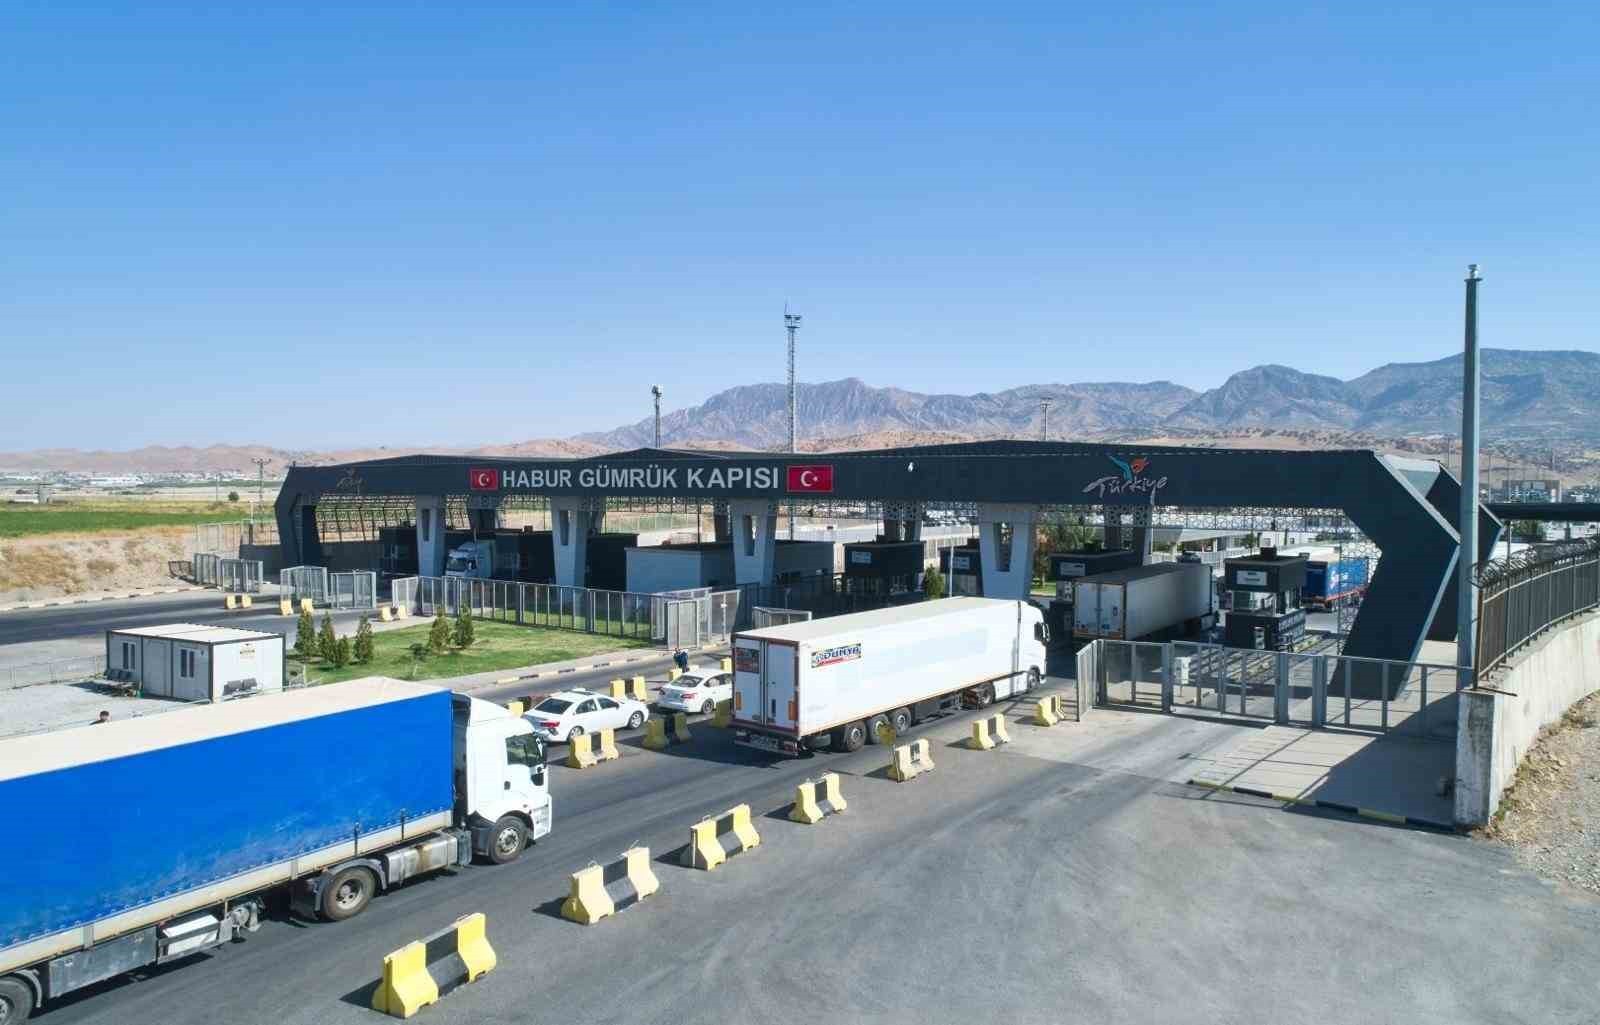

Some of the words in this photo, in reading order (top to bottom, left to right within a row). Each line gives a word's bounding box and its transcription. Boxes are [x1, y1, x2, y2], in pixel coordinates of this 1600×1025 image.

[502, 469, 573, 488] HABUR
[579, 465, 678, 488] GÜMRÜK
[688, 467, 778, 489] KAPISI
[1081, 475, 1168, 506] Türkiye
